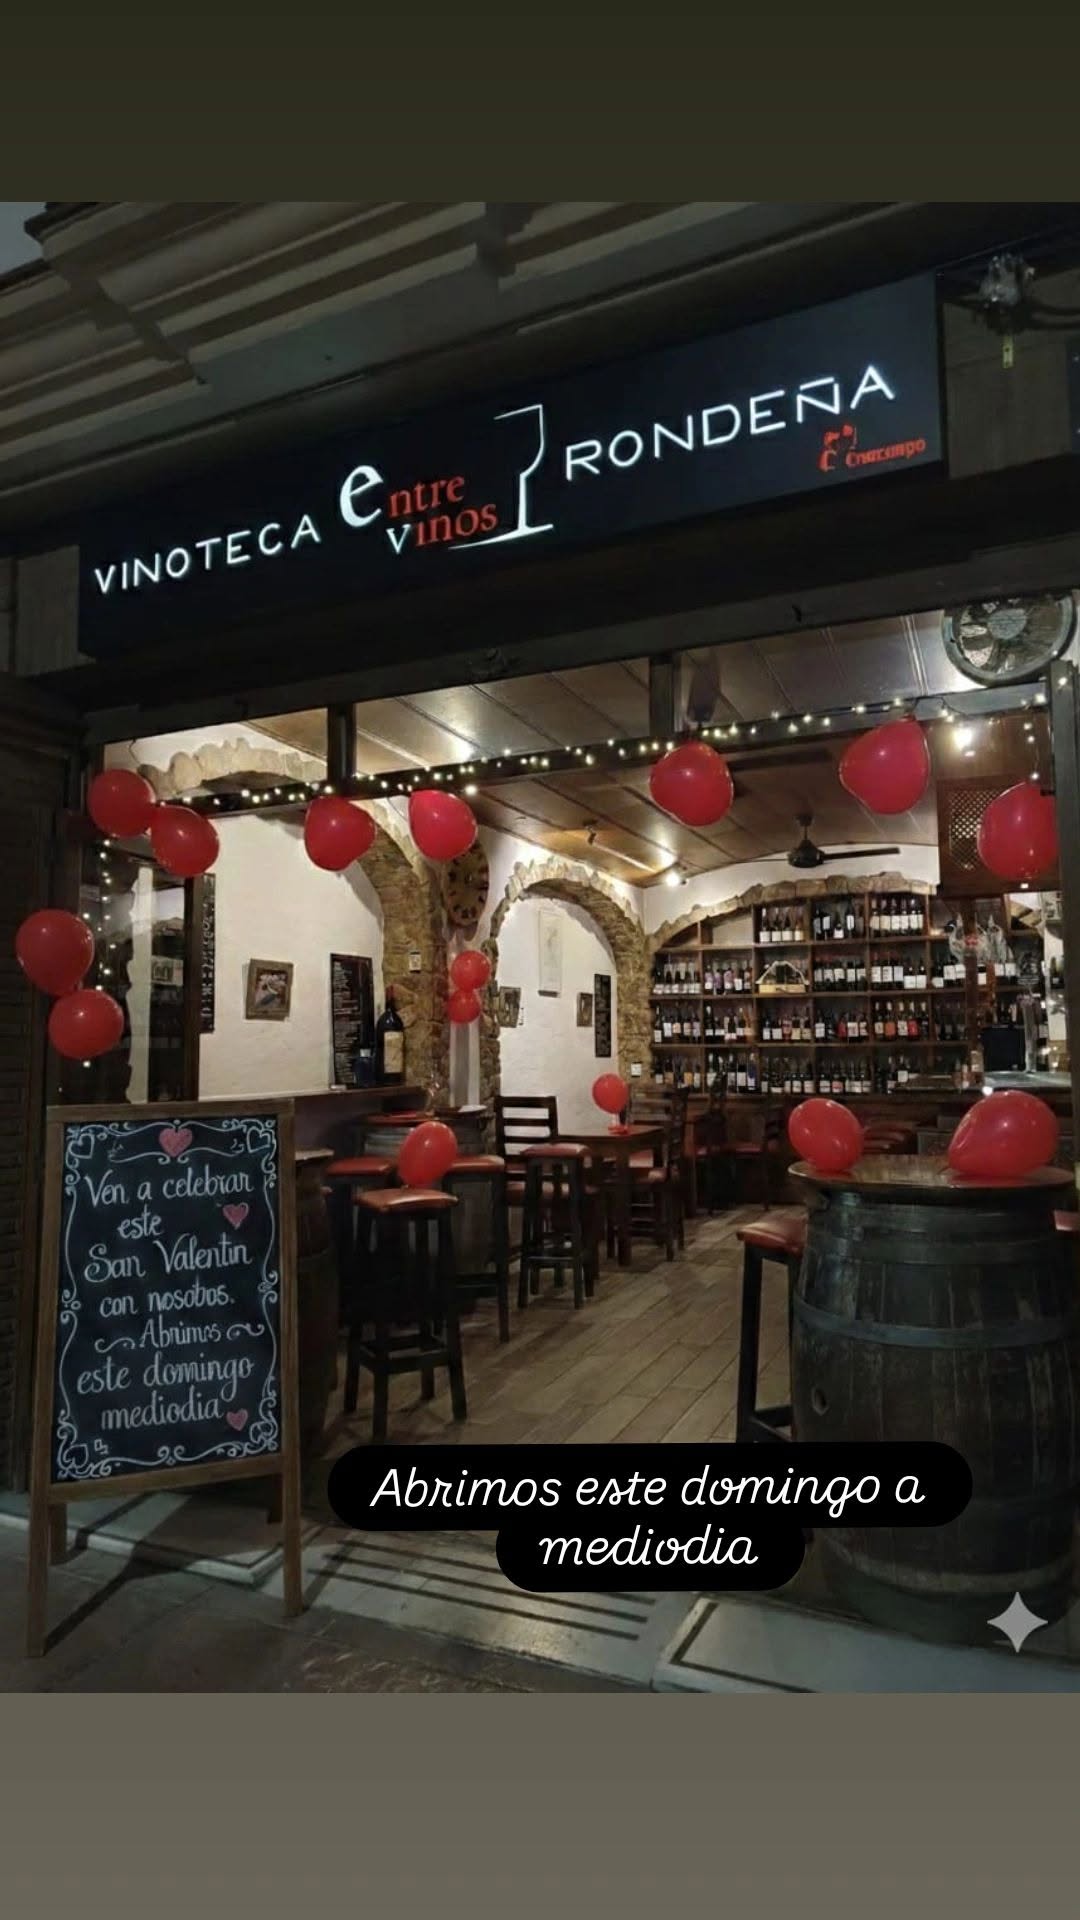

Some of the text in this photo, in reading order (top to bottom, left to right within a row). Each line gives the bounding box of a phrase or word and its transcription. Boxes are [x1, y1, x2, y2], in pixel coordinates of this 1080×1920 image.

[566, 364, 896, 482] RONDEÑA
[339, 464, 465, 528] entre
[94, 514, 321, 594] VINOTECA
[386, 503, 500, 555] vinos
[84, 1164, 254, 1207] Ven a celebrar
[117, 1204, 163, 1240] este
[84, 1231, 253, 1283] San Valentin
[99, 1295, 138, 1318] con
[77, 1351, 255, 1403] este domingo
[101, 1385, 224, 1430] mediodia
